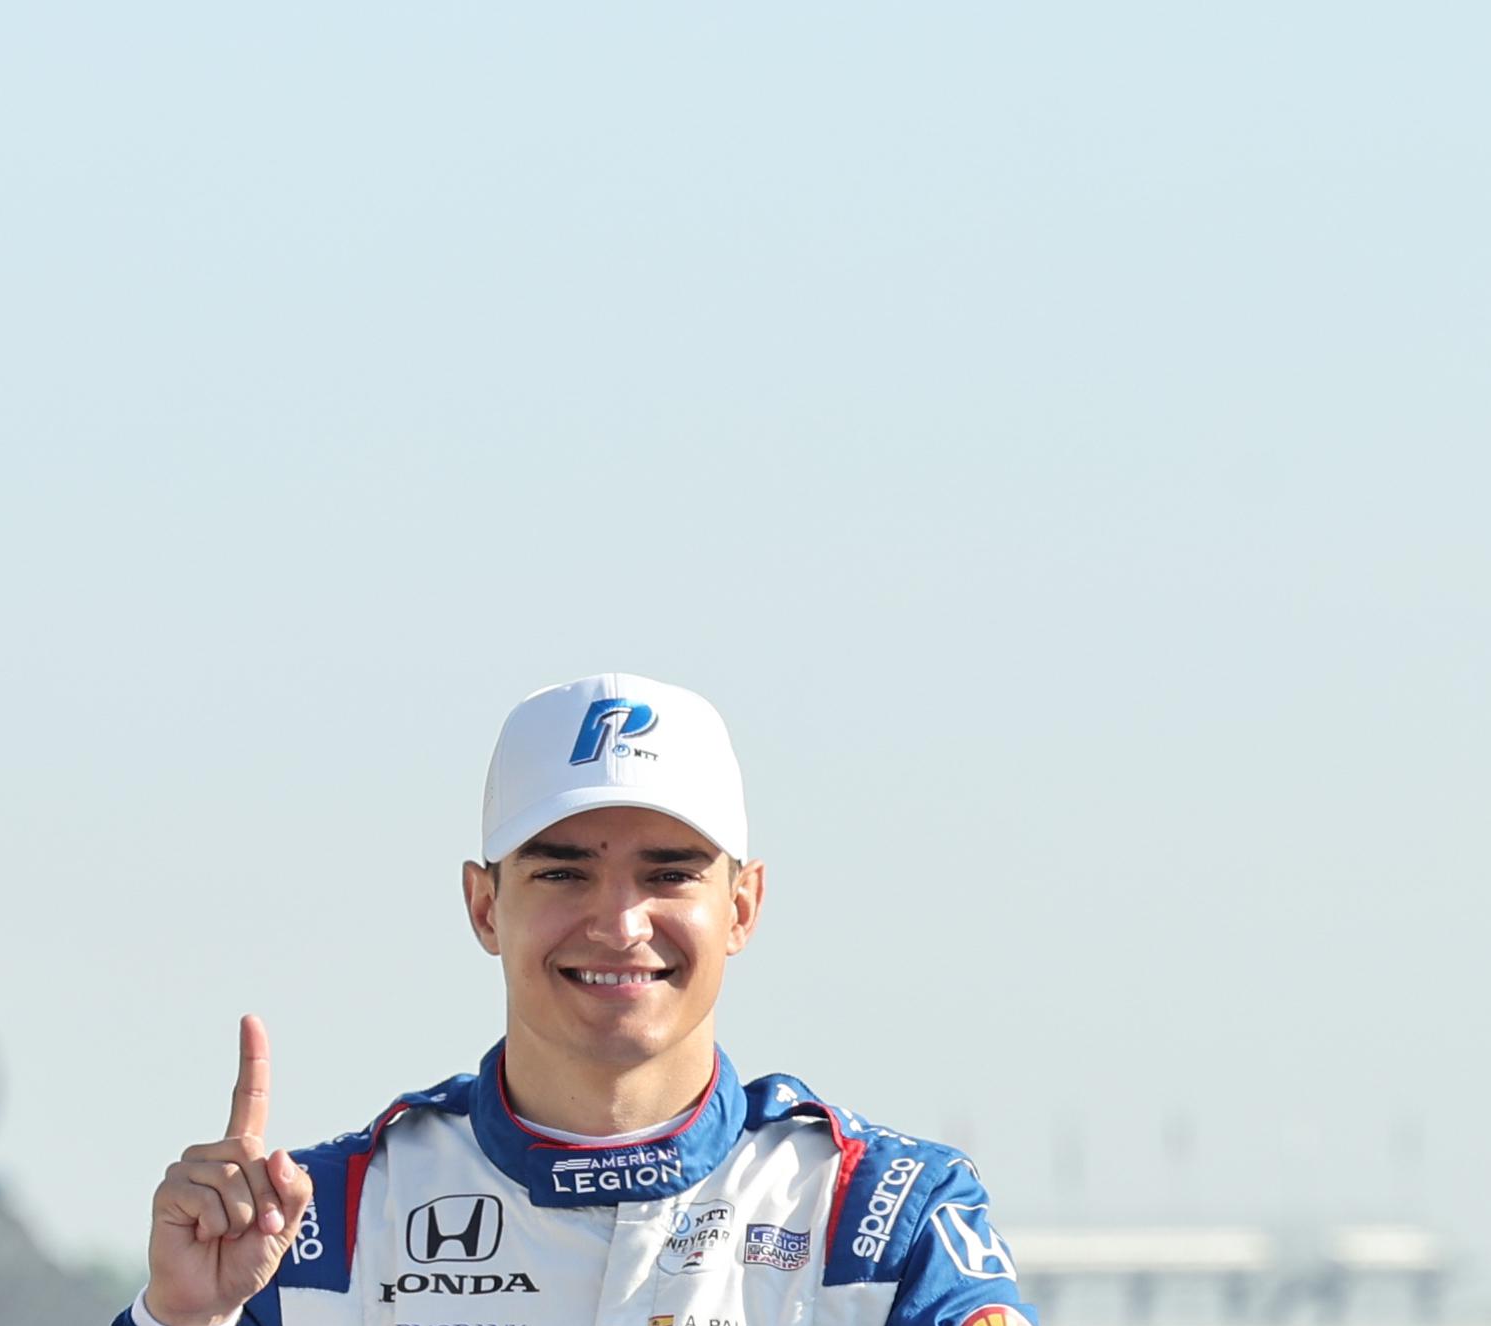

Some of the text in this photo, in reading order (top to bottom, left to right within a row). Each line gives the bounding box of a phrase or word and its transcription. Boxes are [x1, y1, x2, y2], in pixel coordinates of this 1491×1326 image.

[634, 748, 659, 762] NTT
[590, 1147, 680, 1170] AMERICAN
[553, 1160, 683, 1194] LEGION
[695, 1208, 728, 1228] NTT
[851, 1157, 925, 1263] sparco
